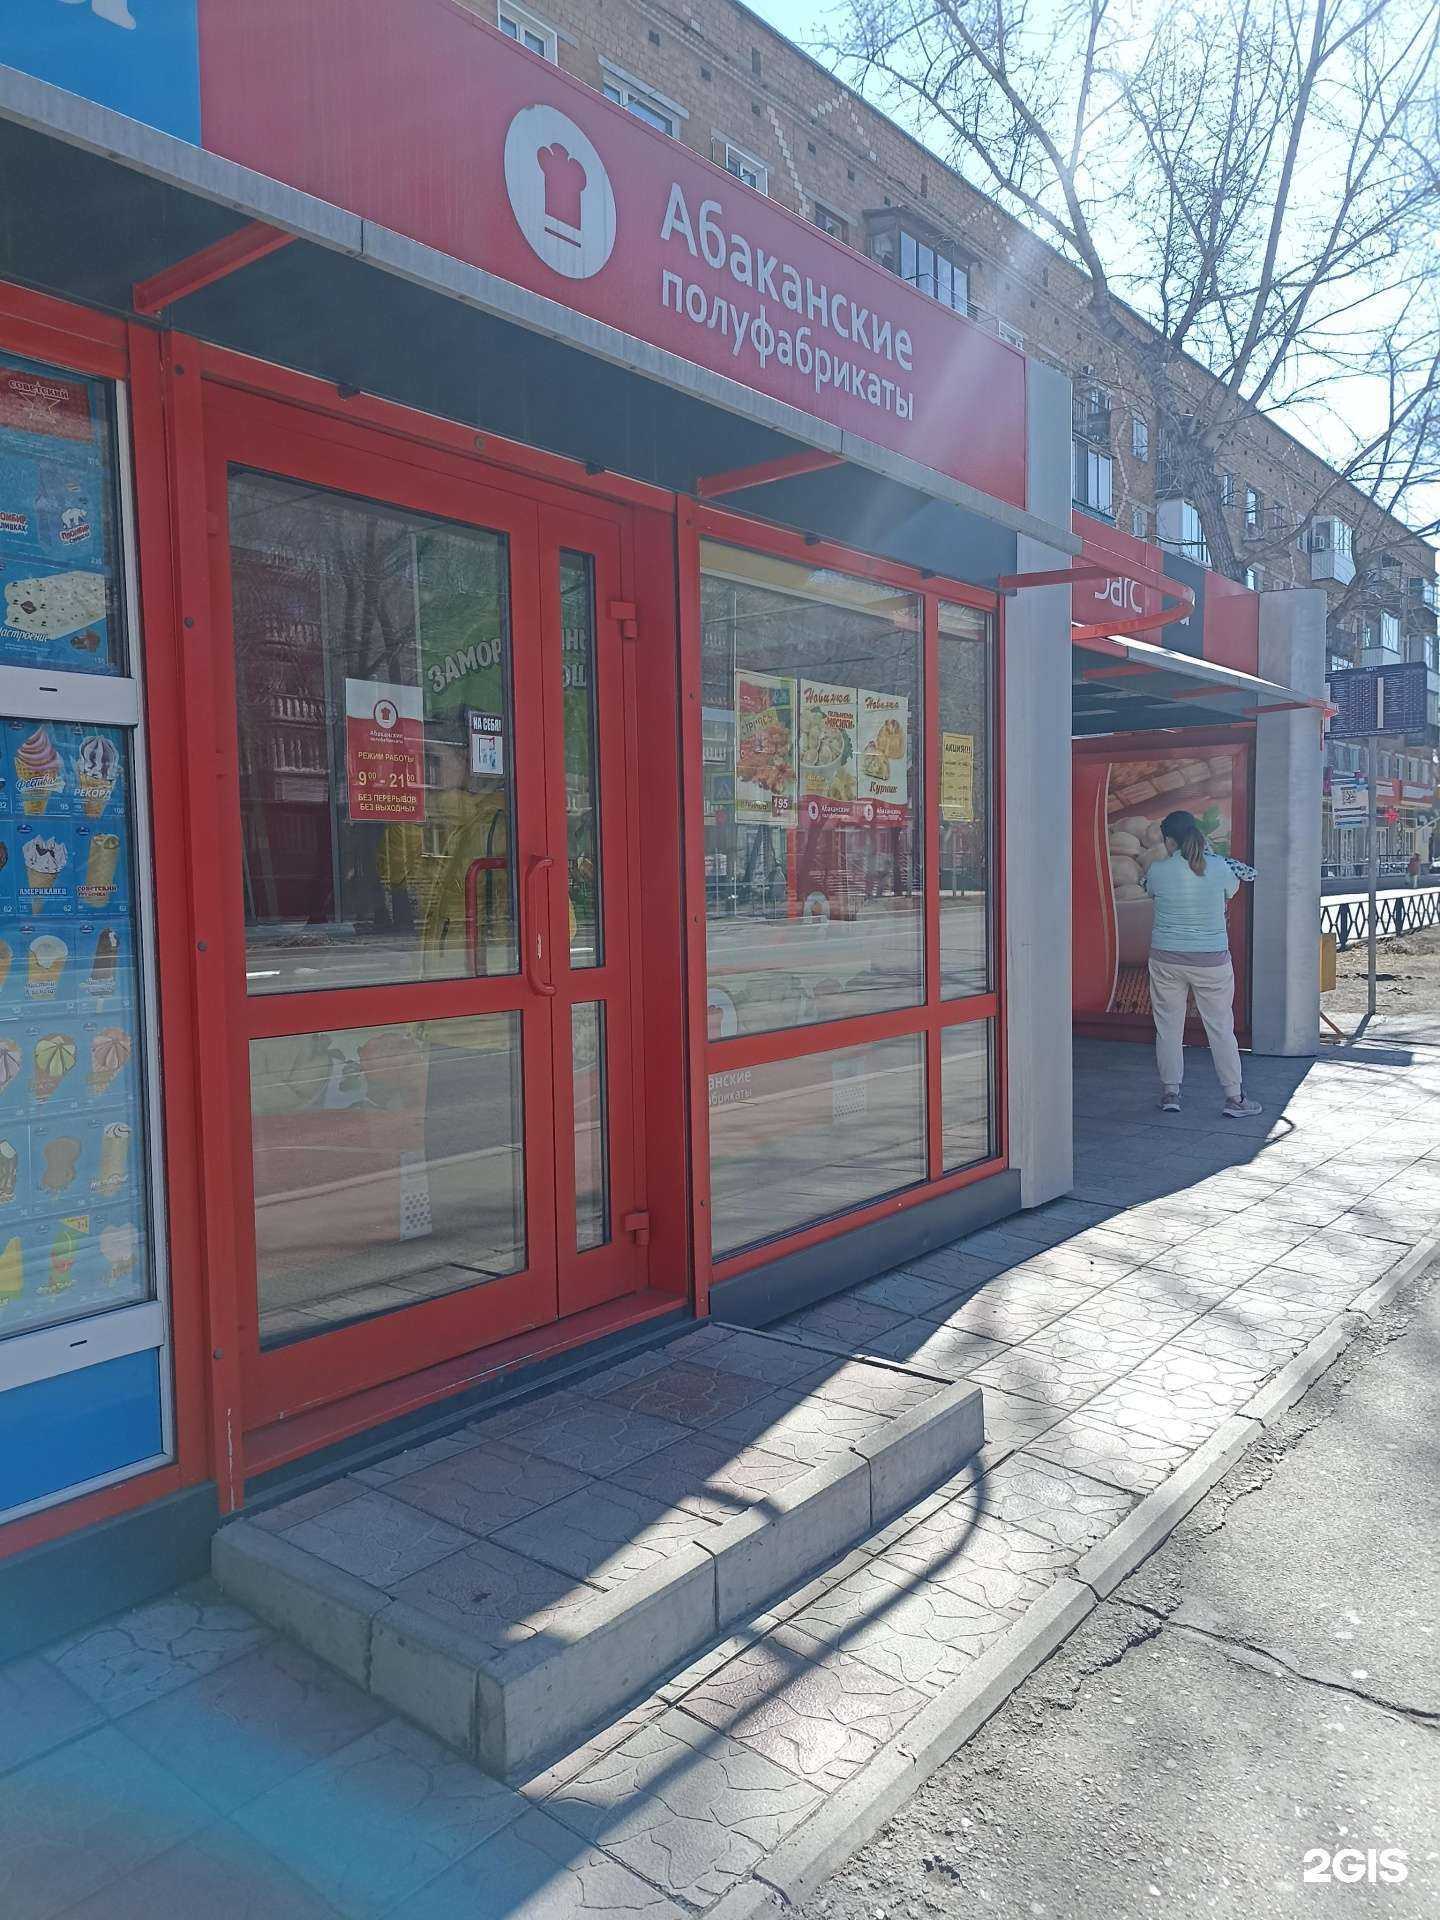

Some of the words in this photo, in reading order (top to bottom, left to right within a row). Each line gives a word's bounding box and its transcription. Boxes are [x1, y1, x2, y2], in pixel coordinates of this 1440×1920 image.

[660, 182, 914, 372] Абаканские
[660, 268, 915, 422] полуфабрикаты
[473, 717, 483, 731] НА
[483, 717, 502, 732] СЕБЯ!
[358, 751, 384, 761] РЕЖИМ
[385, 753, 415, 763] РАБОТЫ
[358, 793, 372, 802] БЕЗ
[373, 794, 417, 803] ПЕРЕРЫВОВ
[360, 803, 374, 811] БЕЗ
[375, 804, 416, 812] ВЫХОДНЫХ
